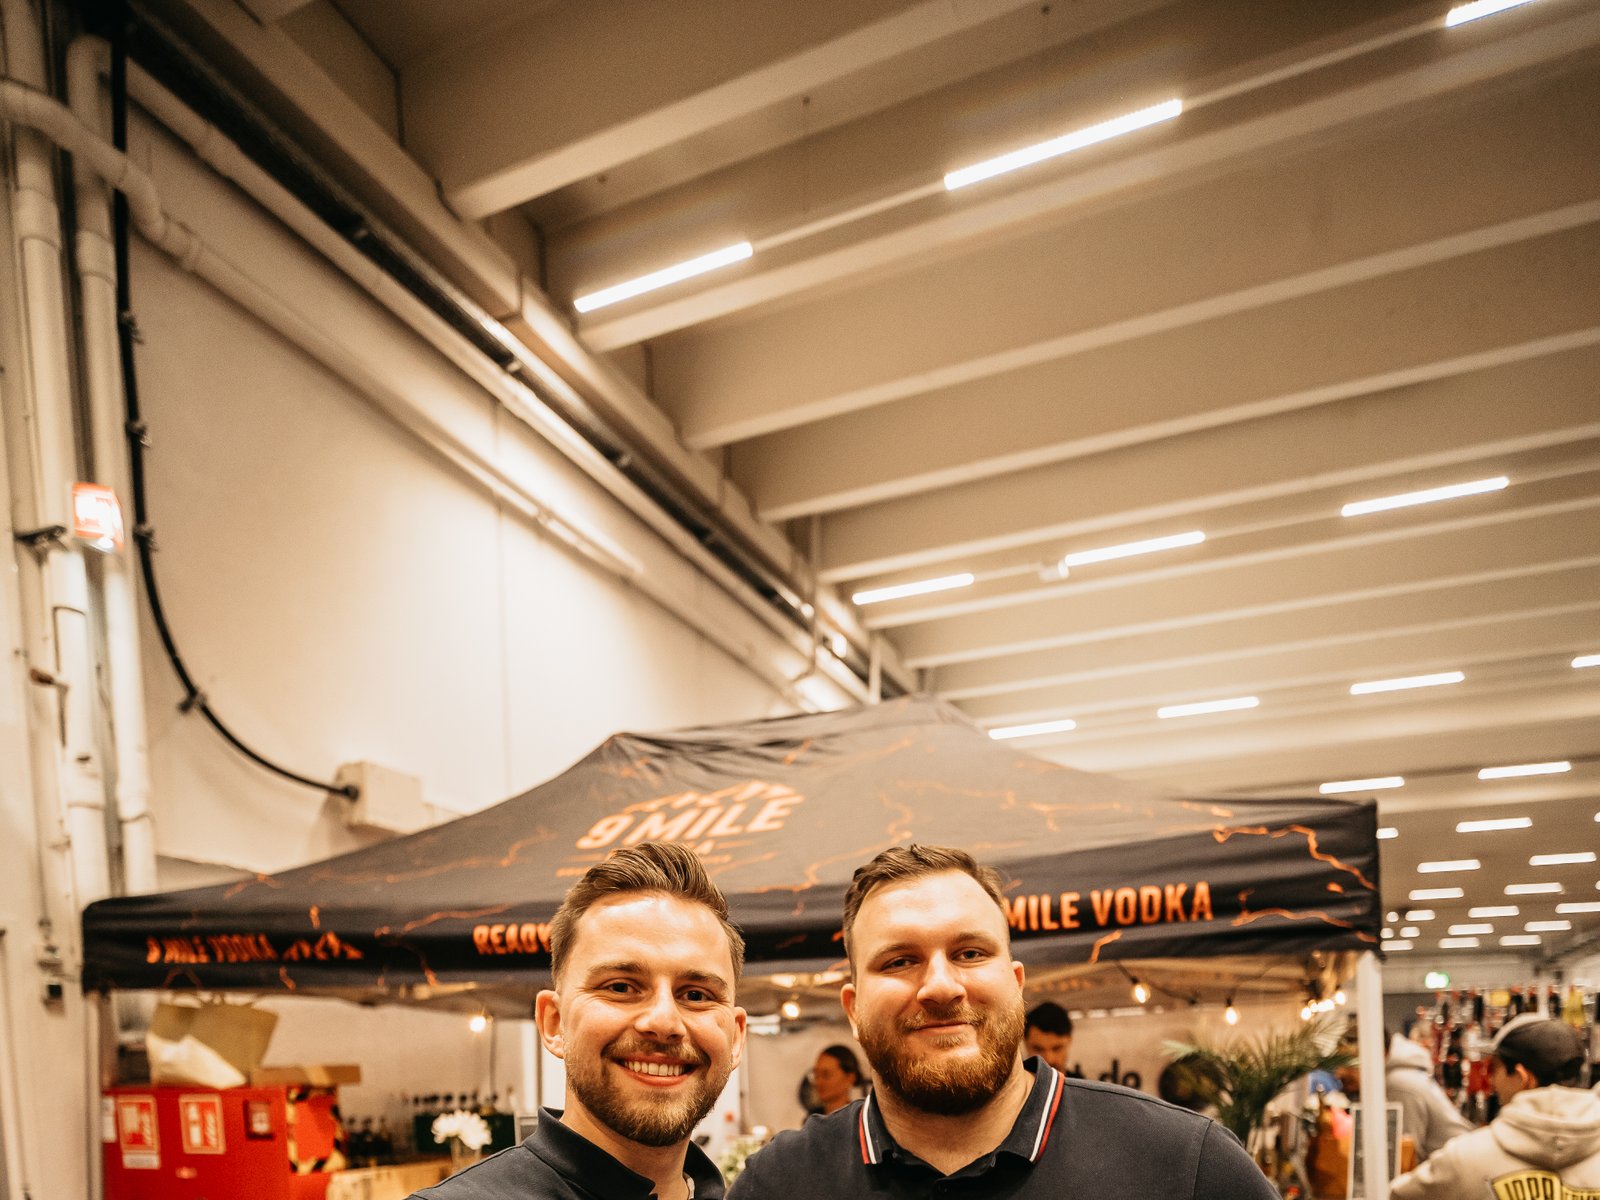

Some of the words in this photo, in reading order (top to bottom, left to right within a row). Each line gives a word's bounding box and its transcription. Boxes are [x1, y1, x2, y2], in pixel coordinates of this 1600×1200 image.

[576, 813, 634, 848] 9
[621, 796, 803, 845] MILE
[1004, 891, 1080, 931] MILE
[1091, 881, 1214, 926] VODKA
